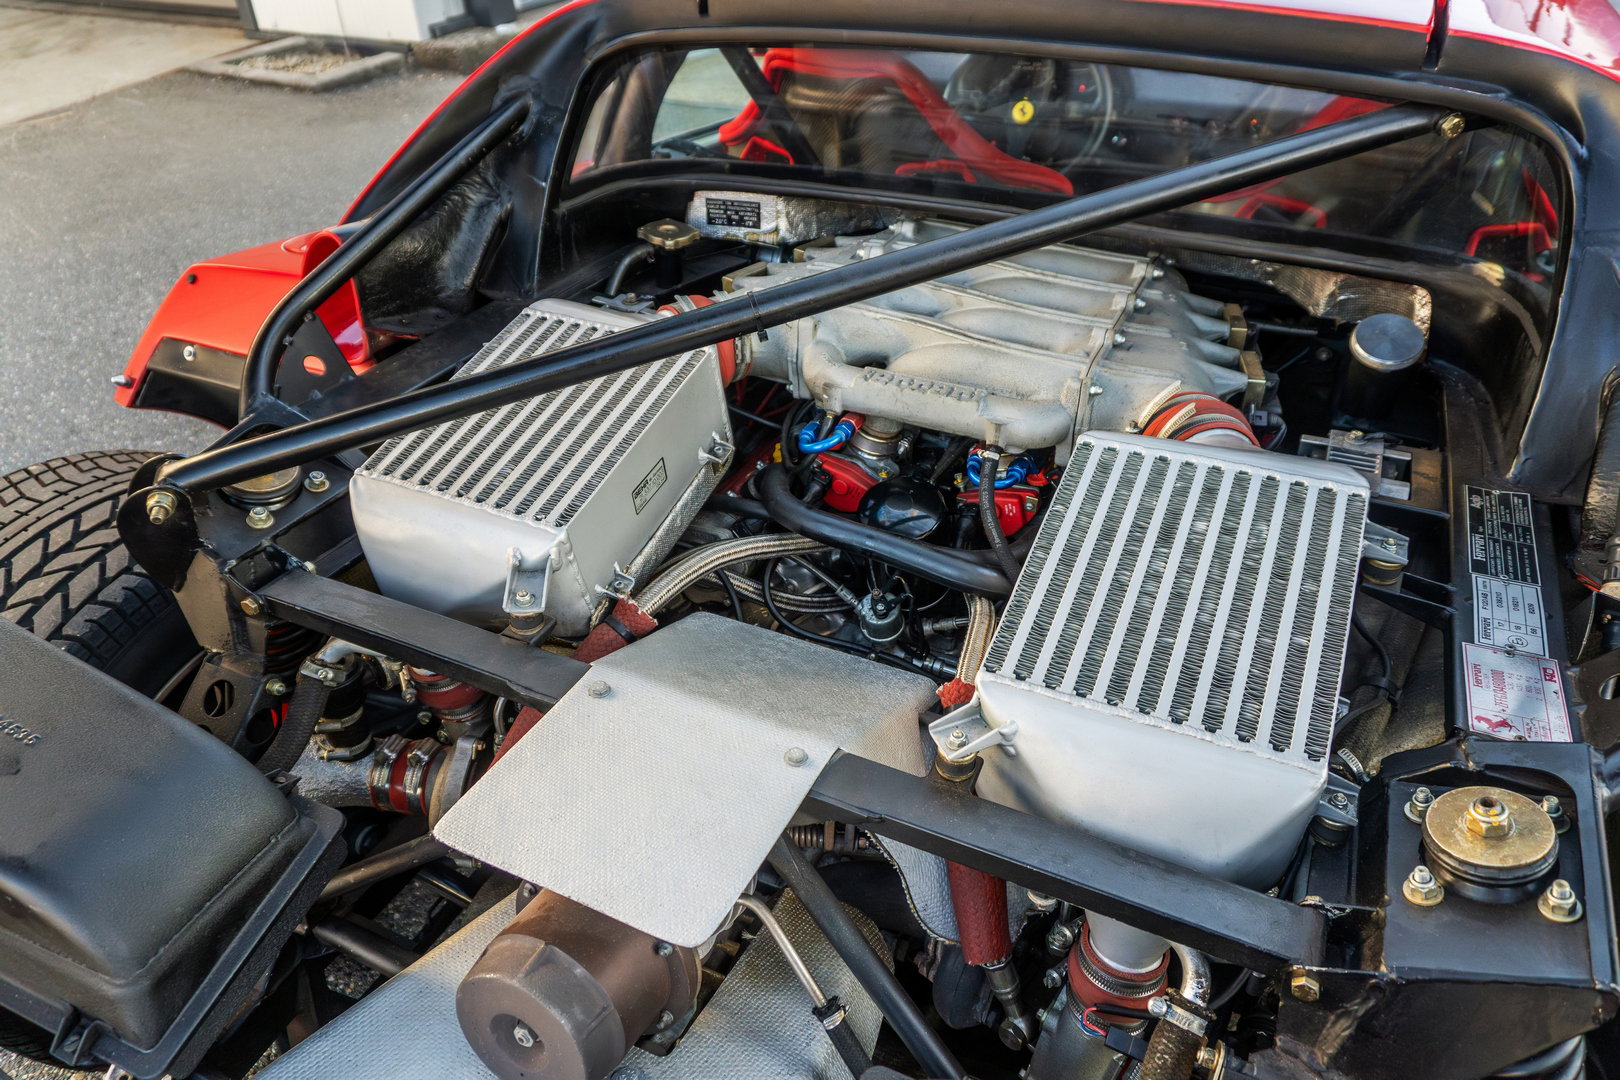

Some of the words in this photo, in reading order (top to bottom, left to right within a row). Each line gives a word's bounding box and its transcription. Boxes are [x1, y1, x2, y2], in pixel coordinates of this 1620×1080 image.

[1470, 494, 1484, 509] Agip
[1472, 533, 1486, 561] Ferrari
[1481, 616, 1492, 640] Ferrari
[1470, 662, 1483, 688] Ferrari
[1542, 667, 1557, 683] F40
